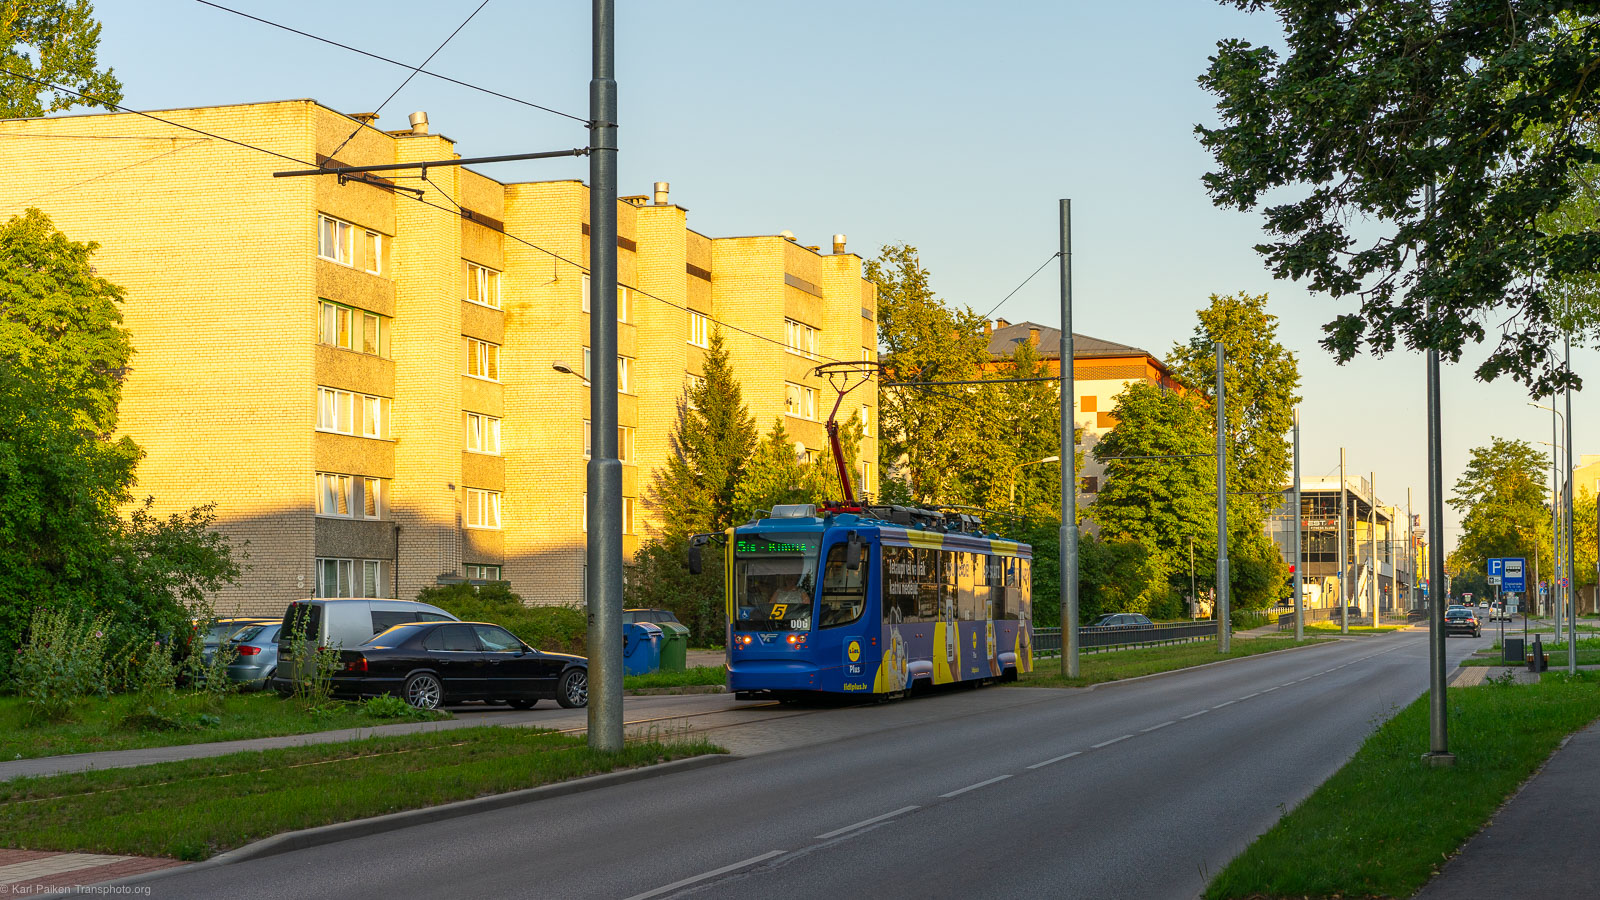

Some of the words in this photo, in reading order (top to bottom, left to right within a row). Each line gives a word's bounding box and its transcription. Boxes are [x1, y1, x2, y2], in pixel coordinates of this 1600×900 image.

[1492, 560, 1501, 574] P
[773, 606, 784, 617] 5
[790, 619, 808, 629] 006
[849, 665, 860, 674] Plus
[843, 683, 868, 693] lidlplus.lv
